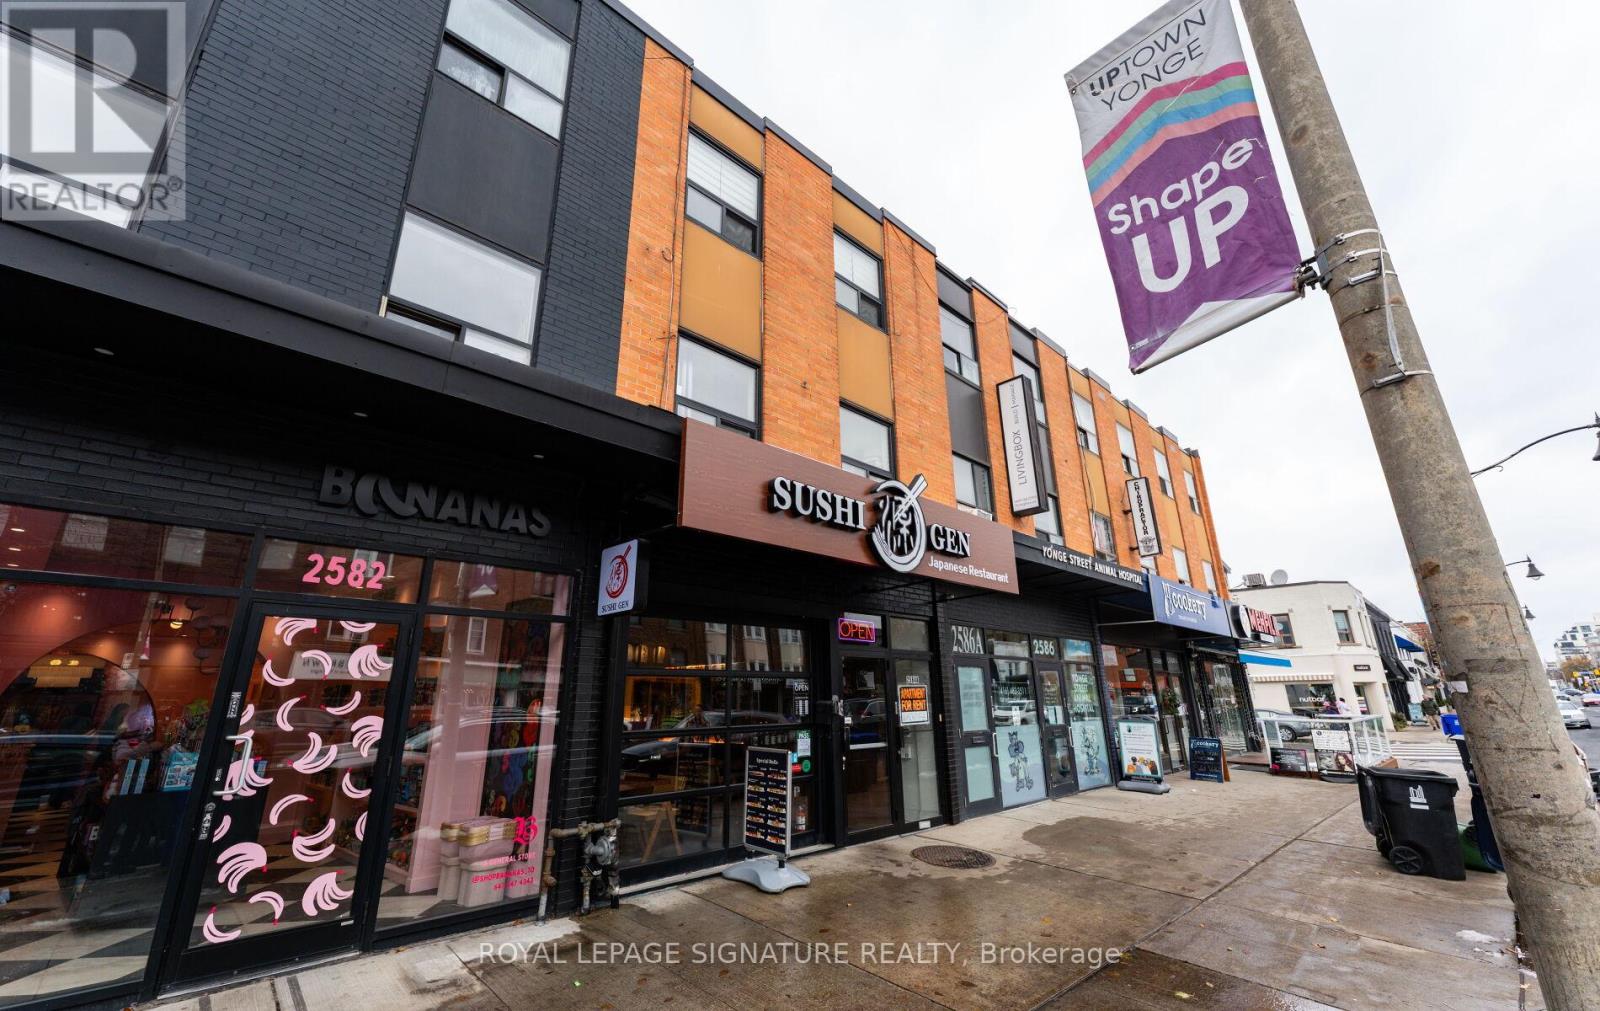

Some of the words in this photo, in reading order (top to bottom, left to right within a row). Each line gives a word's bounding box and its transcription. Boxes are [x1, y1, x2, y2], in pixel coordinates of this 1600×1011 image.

[1090, 8, 1206, 97] UPTOWN
[1101, 38, 1204, 111] YONGE
[1132, 185, 1249, 293] UP
[1012, 430, 1027, 486] LIVINGBOX
[771, 476, 867, 530] SUSHI
[929, 523, 971, 557] GEN
[302, 553, 387, 590] 2582
[928, 556, 968, 574] Japanese
[968, 564, 1009, 584] Restaurant
[1042, 545, 1067, 563] YONGE
[1069, 554, 1092, 570] STREET
[1094, 562, 1117, 578] ANIMAL
[1118, 570, 1143, 585] HOSPITAL
[601, 603, 617, 614] SUSHI
[617, 600, 629, 610] GEN
[840, 621, 873, 640] OPEN
[951, 625, 984, 655] 2586A
[1033, 639, 1056, 656] 2586
[901, 699, 912, 711] FOR
[913, 699, 927, 711] RENT
